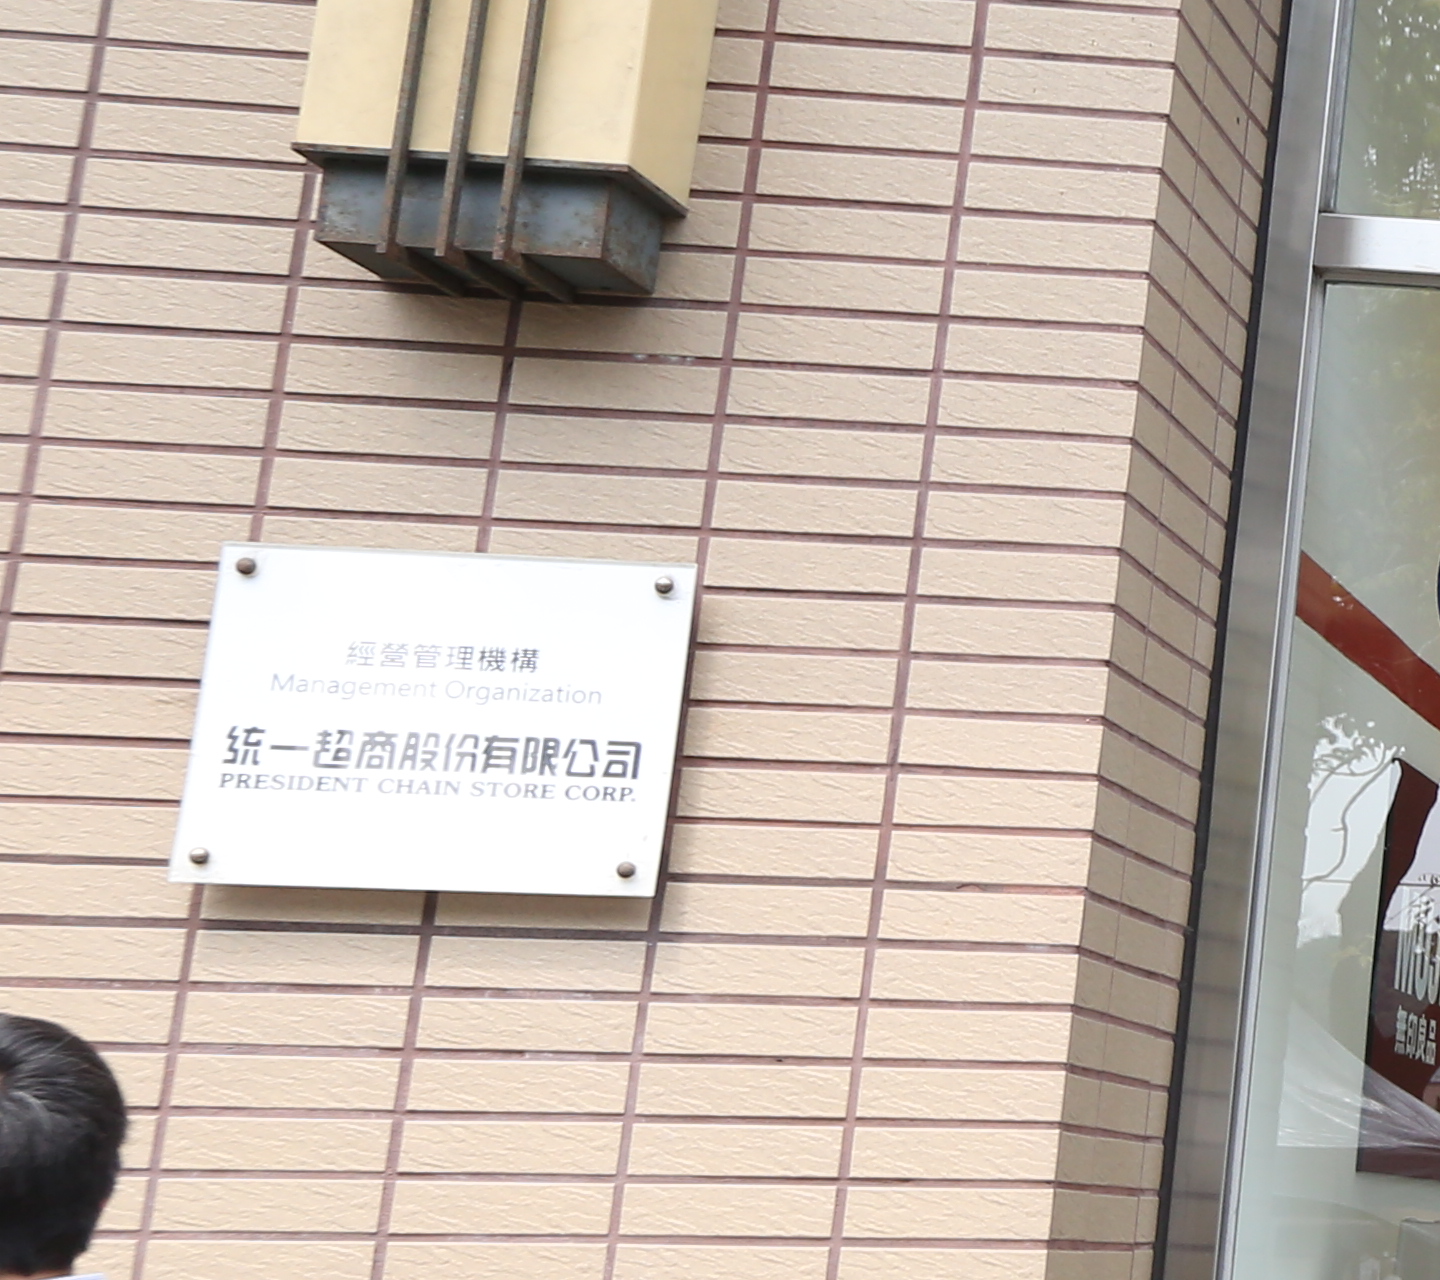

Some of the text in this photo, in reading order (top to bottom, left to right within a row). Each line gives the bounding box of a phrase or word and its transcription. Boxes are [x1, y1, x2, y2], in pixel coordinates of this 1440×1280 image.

[345, 640, 541, 674] 經營管理機構
[270, 673, 603, 706] Management Organization
[222, 725, 643, 780] 統一超商股份有限公司
[218, 772, 637, 803] PRESIDENT CHAIN STORE CORP.
[1394, 1004, 1438, 1067] 無印良品
